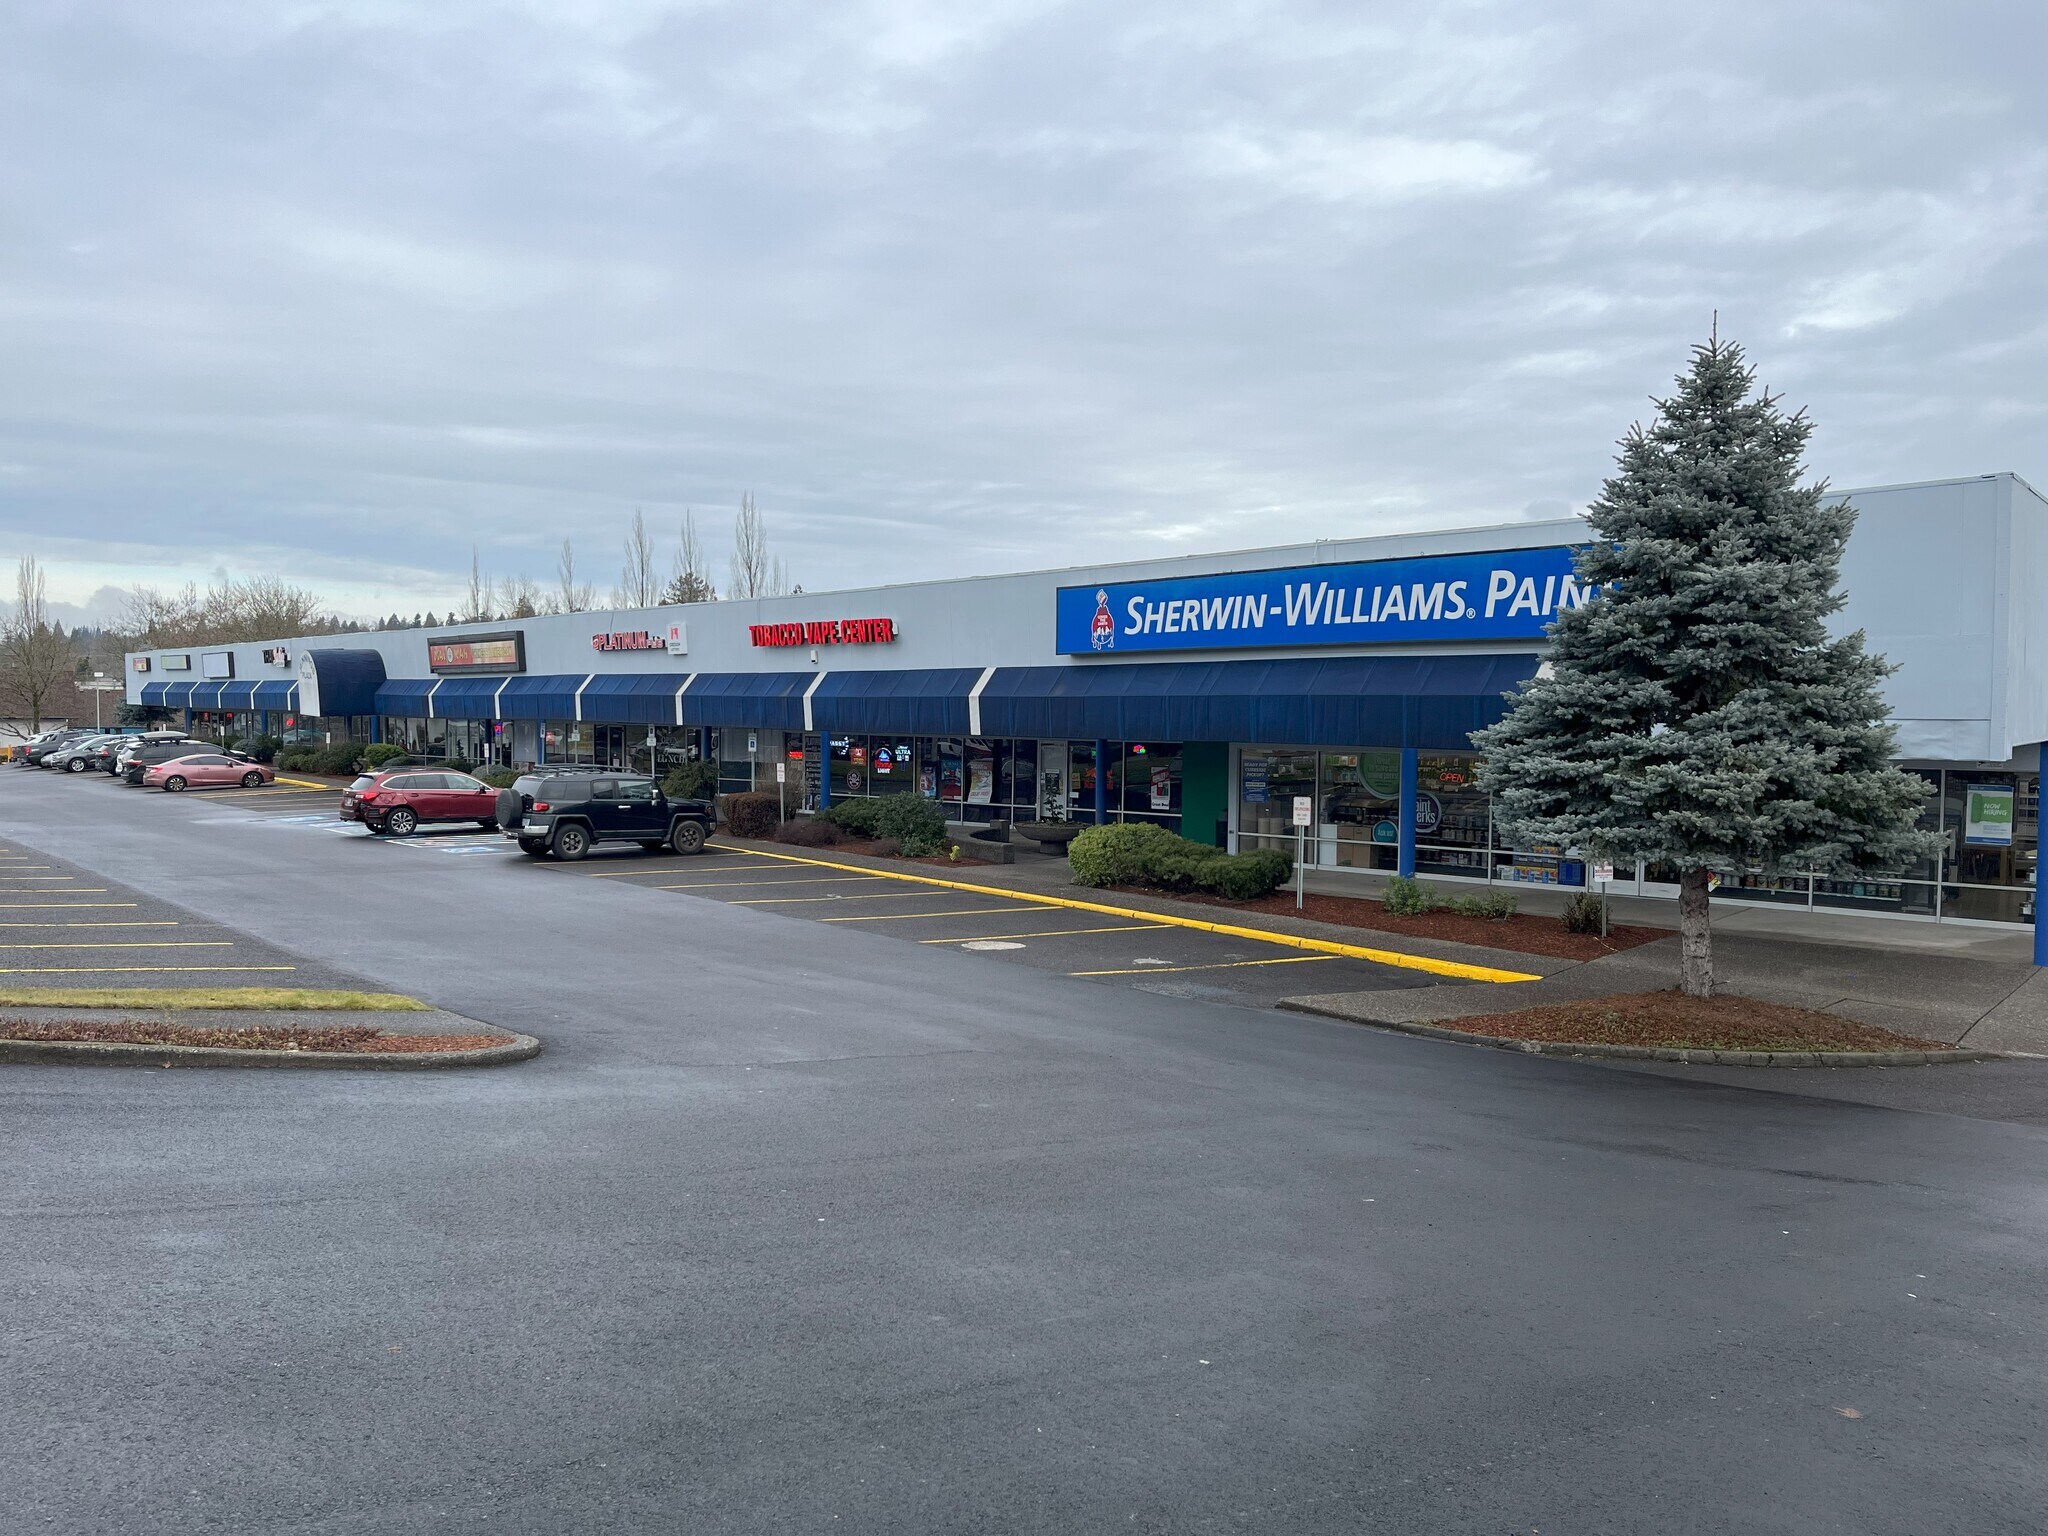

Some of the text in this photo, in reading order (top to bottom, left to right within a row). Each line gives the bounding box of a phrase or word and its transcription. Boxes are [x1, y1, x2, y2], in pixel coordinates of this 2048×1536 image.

[749, 618, 893, 646] TOBACCO VAPE CENTER
[599, 631, 648, 650] PLATINUM
[1440, 772, 1465, 783] OPEN
[1416, 799, 1431, 812] aint
[1416, 812, 1436, 824] erks
